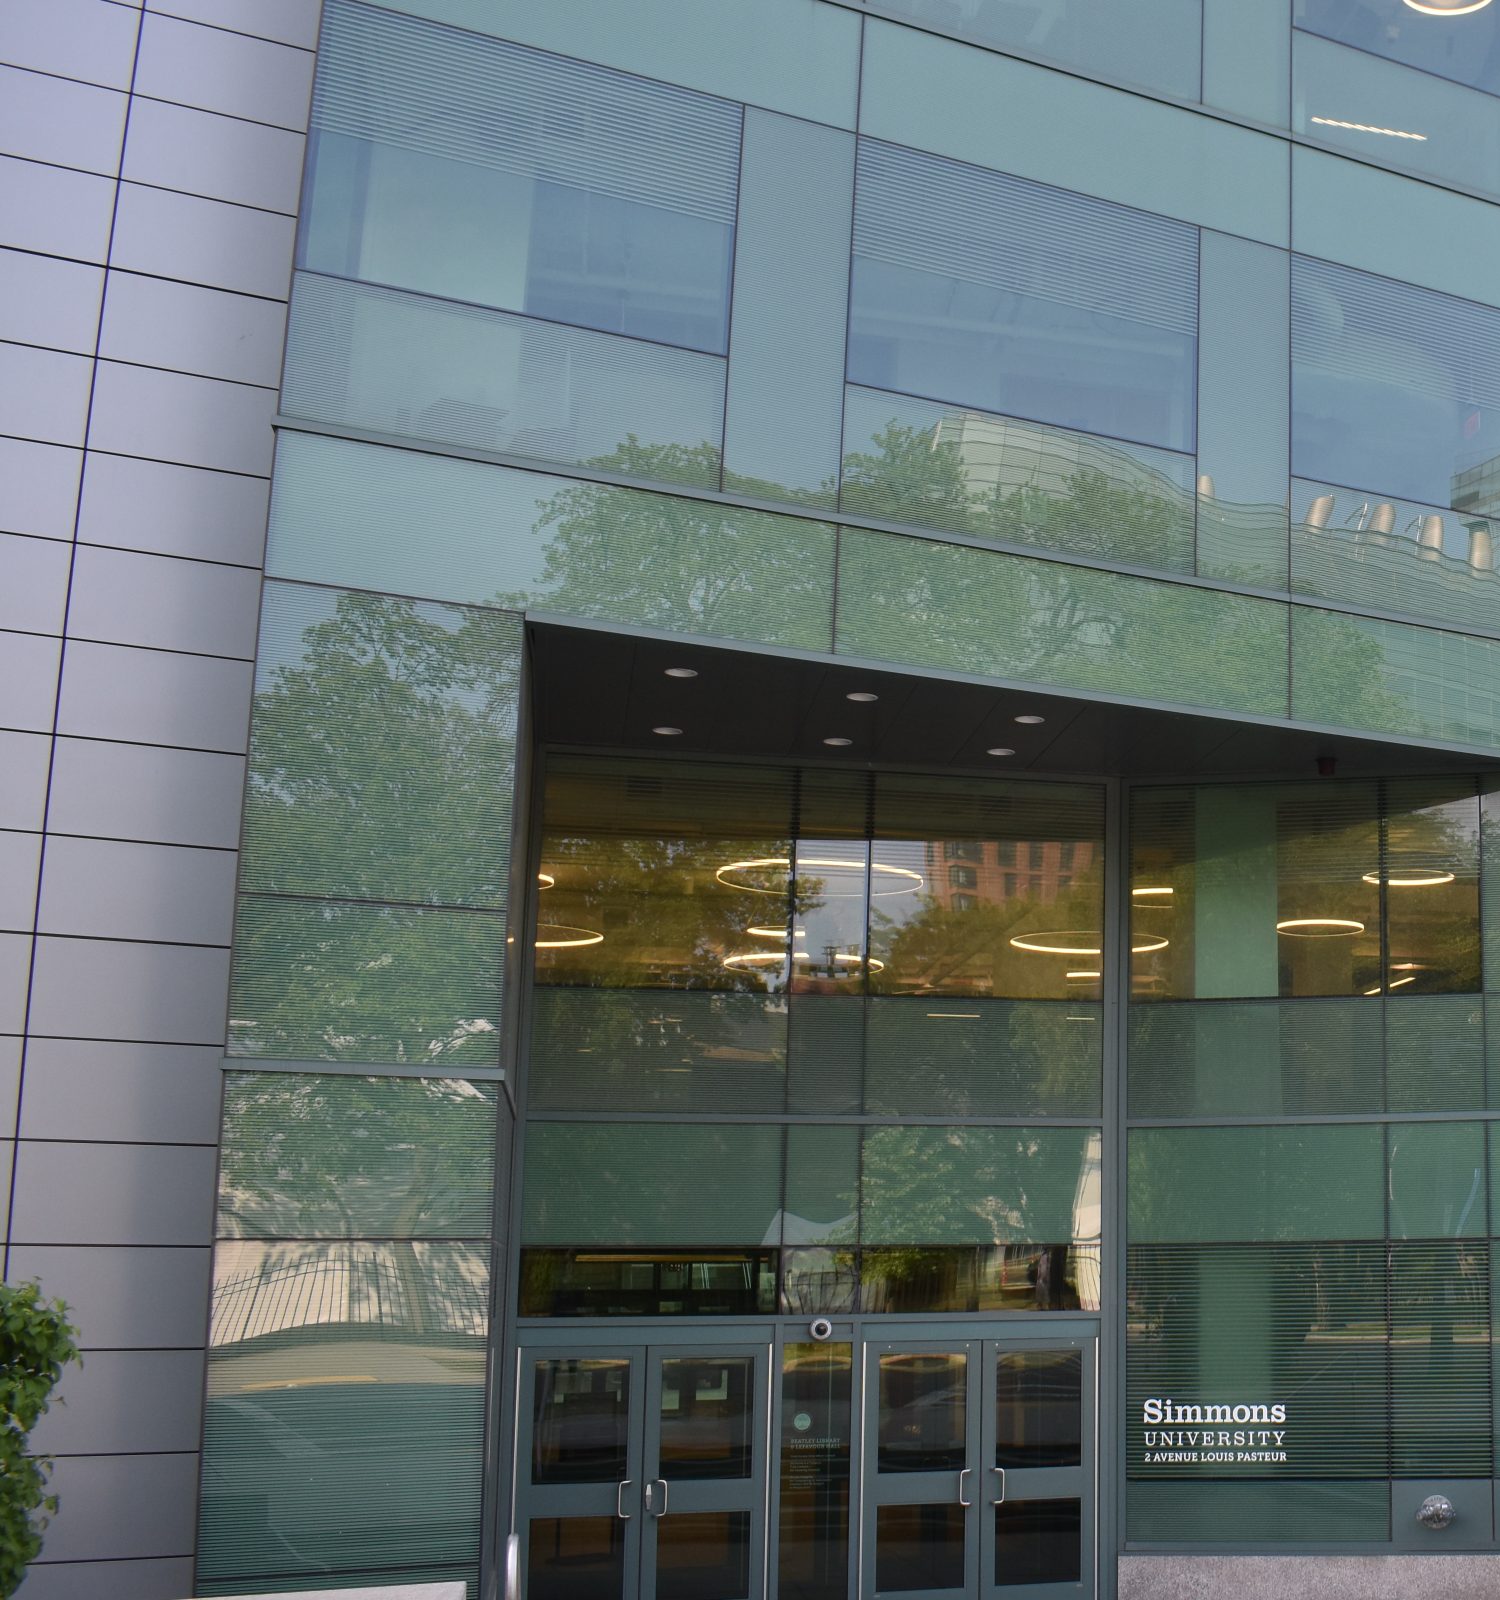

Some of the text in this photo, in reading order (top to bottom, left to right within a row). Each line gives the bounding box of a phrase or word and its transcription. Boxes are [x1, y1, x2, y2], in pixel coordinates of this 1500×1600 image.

[1143, 1399, 1286, 1424] Simmons
[1144, 1431, 1286, 1446] UNIVERSITY
[1144, 1452, 1287, 1462] 2 AVENUE LOUIS PASTEUR
